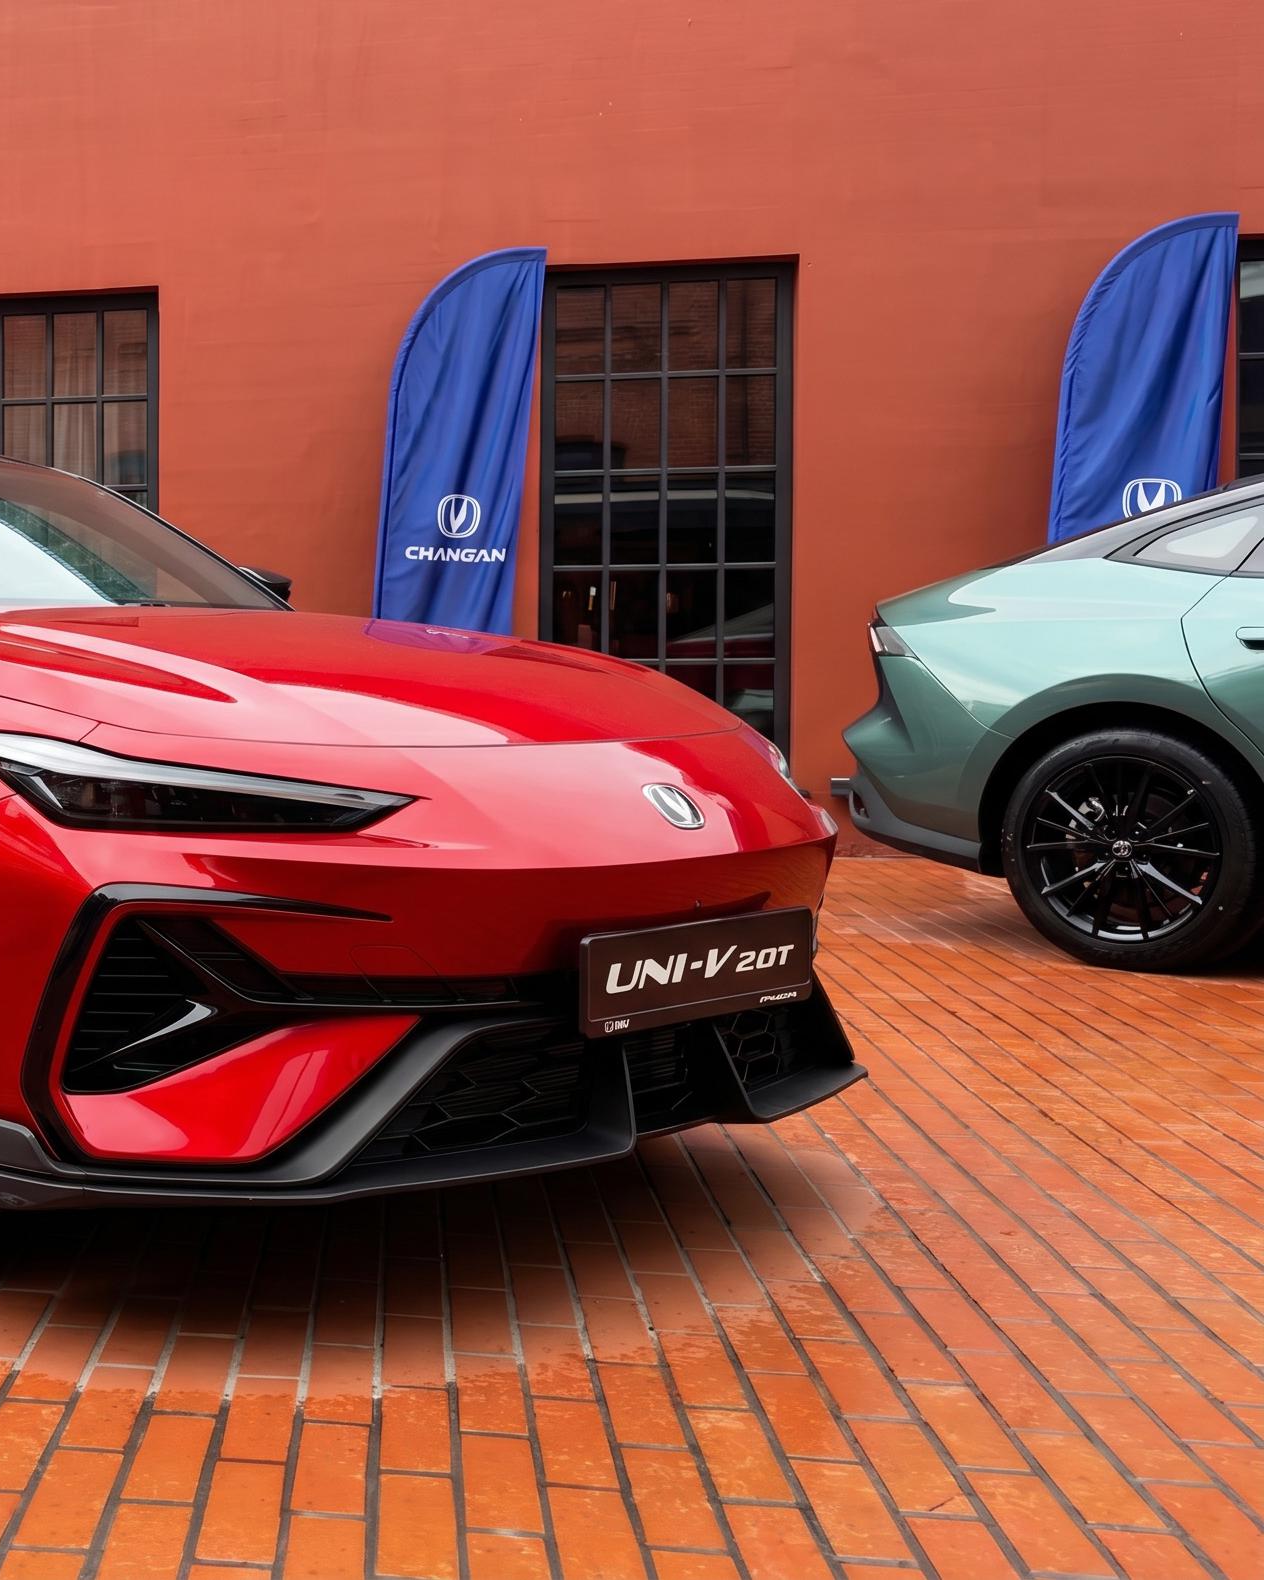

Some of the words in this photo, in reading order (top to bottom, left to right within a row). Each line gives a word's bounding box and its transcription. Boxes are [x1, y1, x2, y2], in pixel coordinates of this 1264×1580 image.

[405, 546, 506, 563] CHANGAN
[605, 945, 737, 994] UNI-V
[736, 944, 795, 973] 20T
